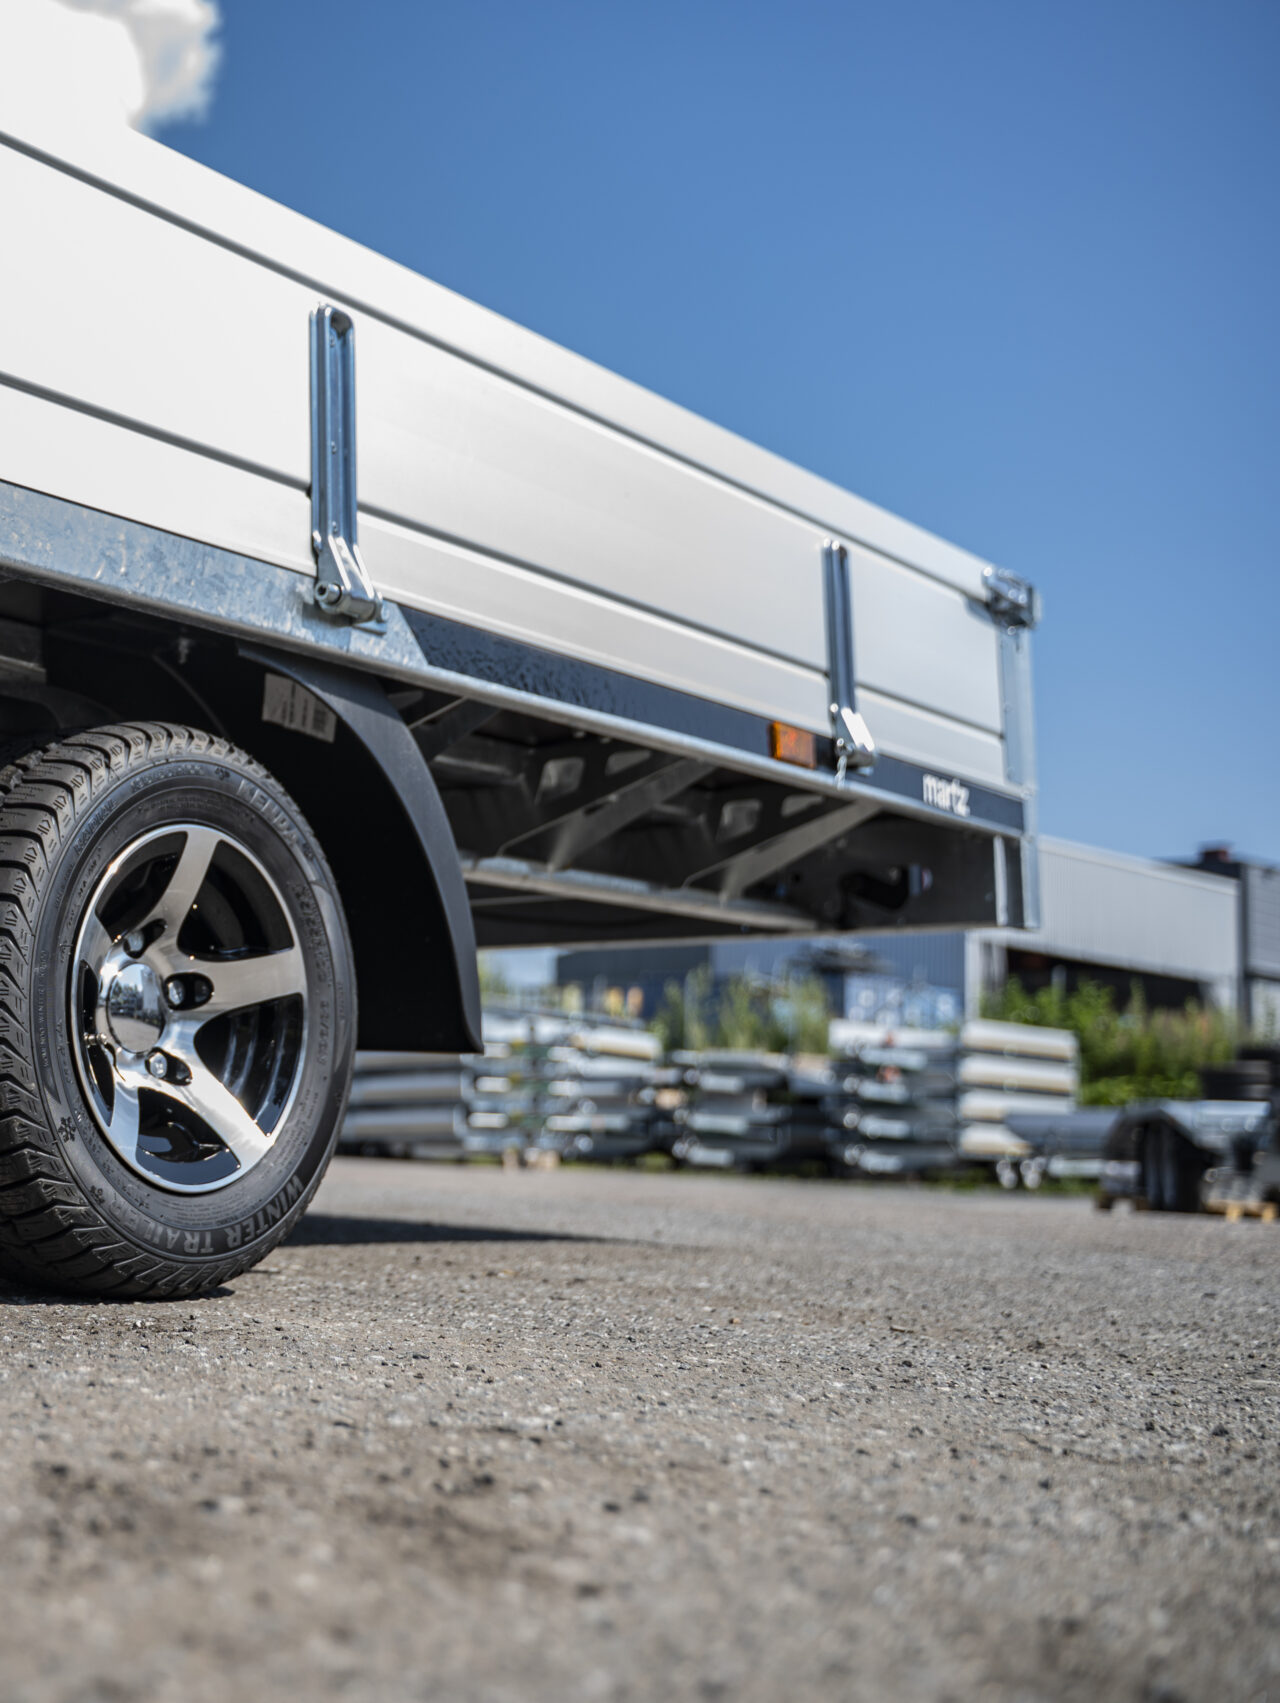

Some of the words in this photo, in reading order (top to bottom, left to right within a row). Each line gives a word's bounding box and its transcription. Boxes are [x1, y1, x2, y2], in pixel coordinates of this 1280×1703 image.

[236, 778, 298, 846] KENDA
[107, 1200, 214, 1254] TRAILER
[225, 1174, 304, 1248] WINTER
